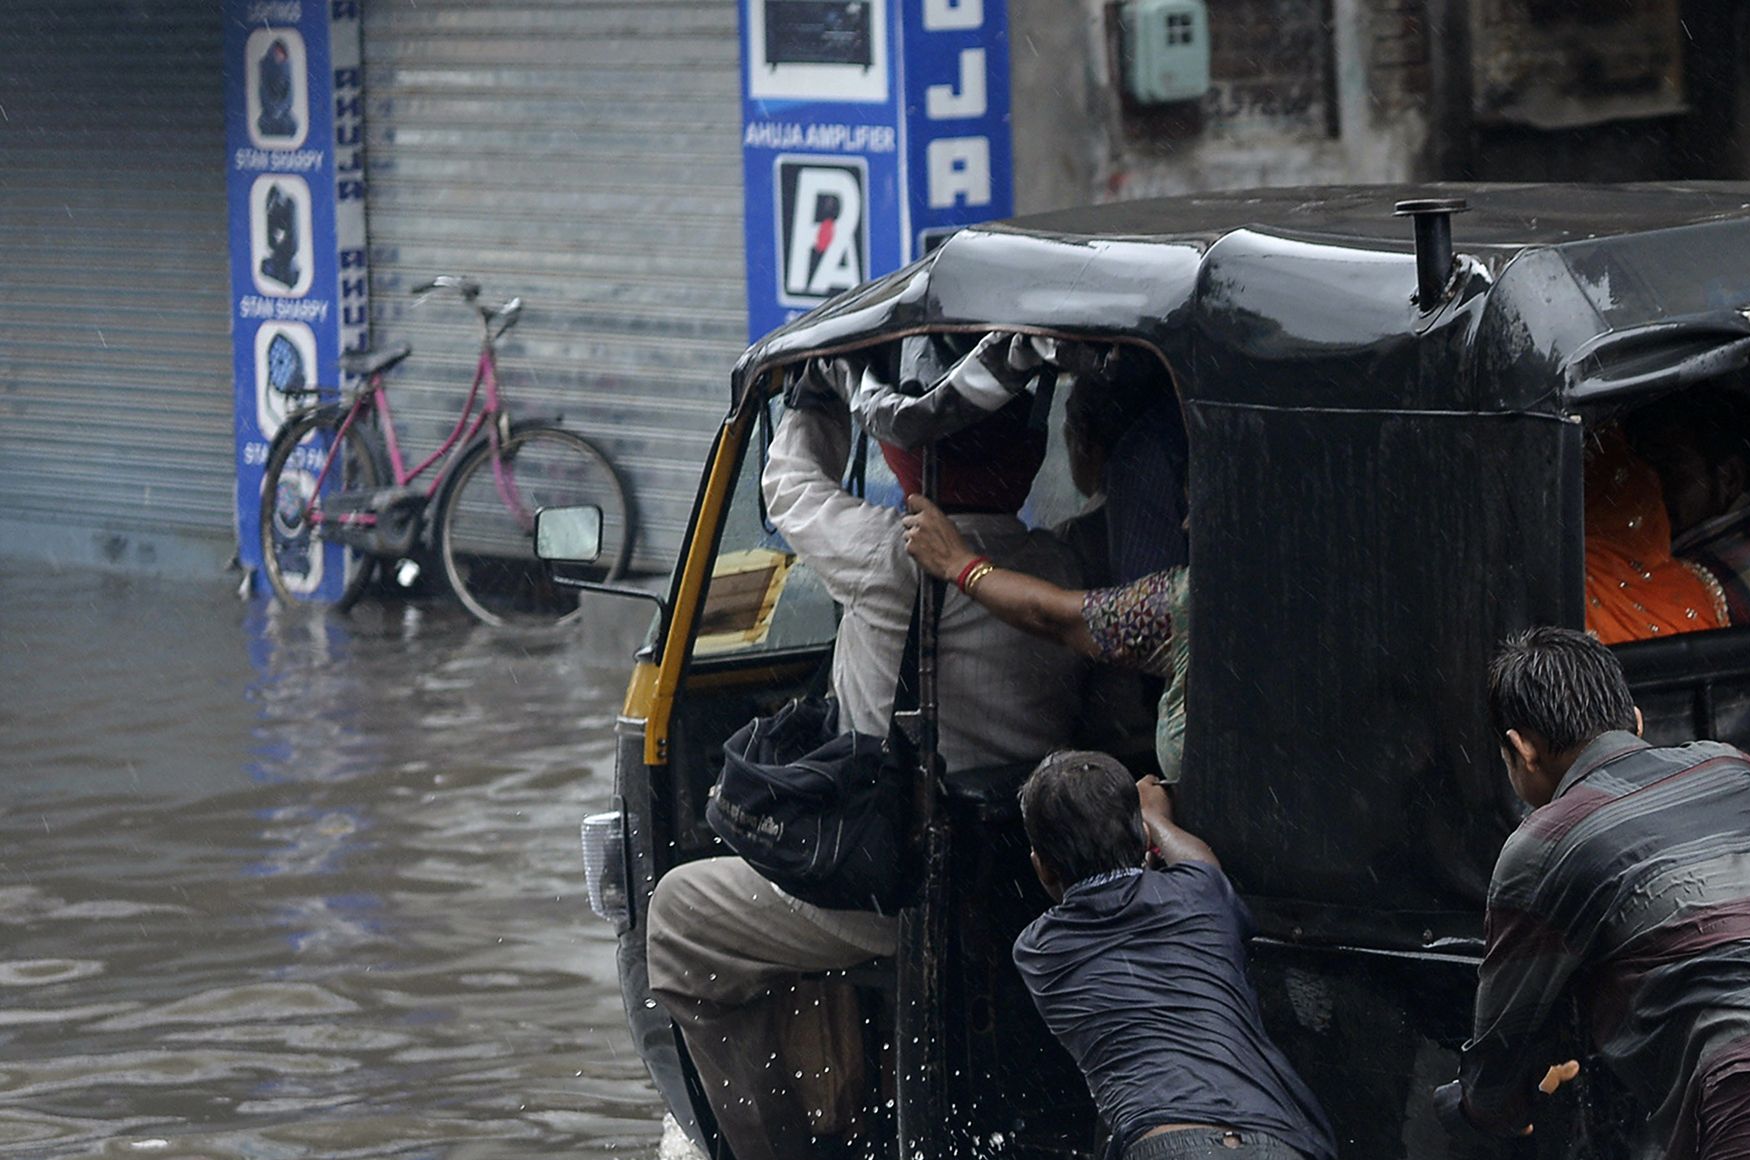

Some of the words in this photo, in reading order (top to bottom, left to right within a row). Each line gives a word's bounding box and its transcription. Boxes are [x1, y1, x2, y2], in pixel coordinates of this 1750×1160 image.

[334, 68, 366, 199] AHUJA
[744, 121, 803, 149] AHUJA
[804, 122, 897, 152] AMPLIFIER
